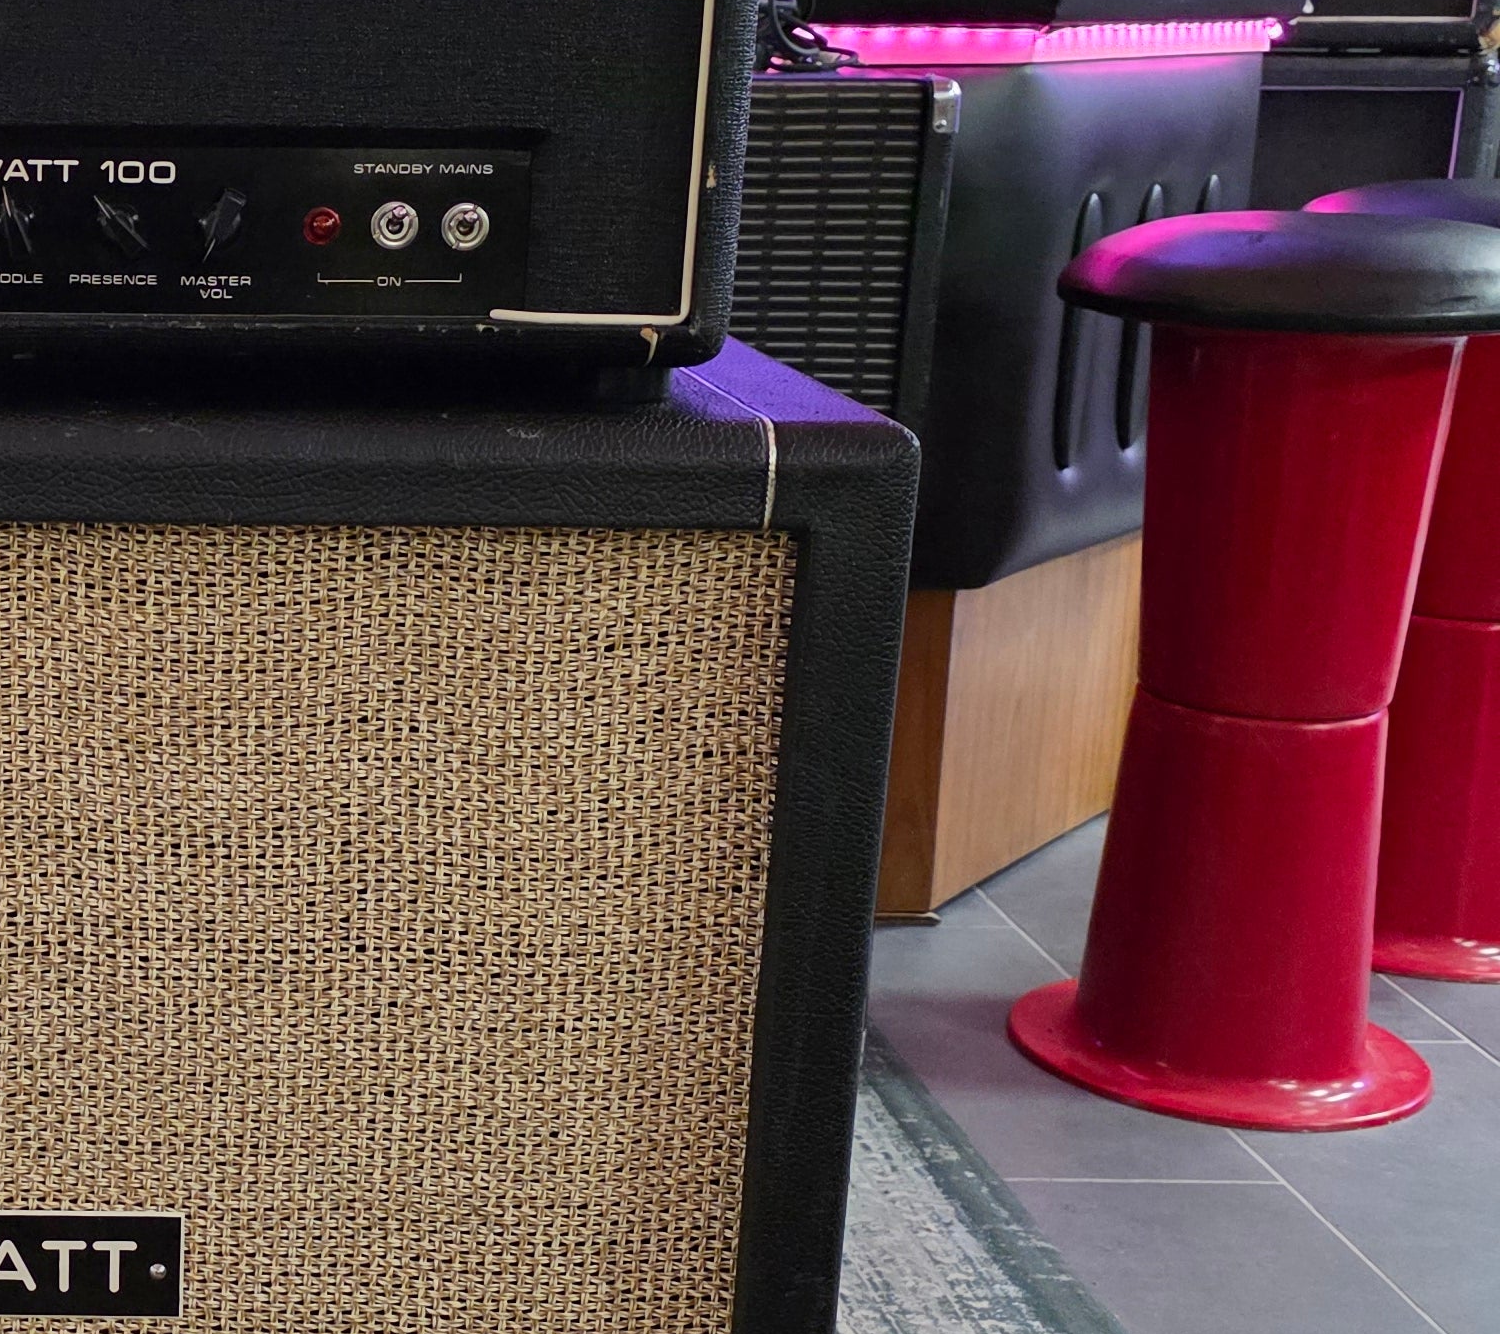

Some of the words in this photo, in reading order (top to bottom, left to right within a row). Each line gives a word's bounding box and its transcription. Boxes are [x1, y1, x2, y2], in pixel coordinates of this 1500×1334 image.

[99, 159, 177, 185] 100
[353, 162, 434, 175] STANDBY
[438, 163, 494, 176] MAINS
[68, 273, 158, 286] PRESENCE
[180, 274, 252, 288] MASTER
[376, 276, 402, 288] ON
[199, 287, 234, 300] VOL
